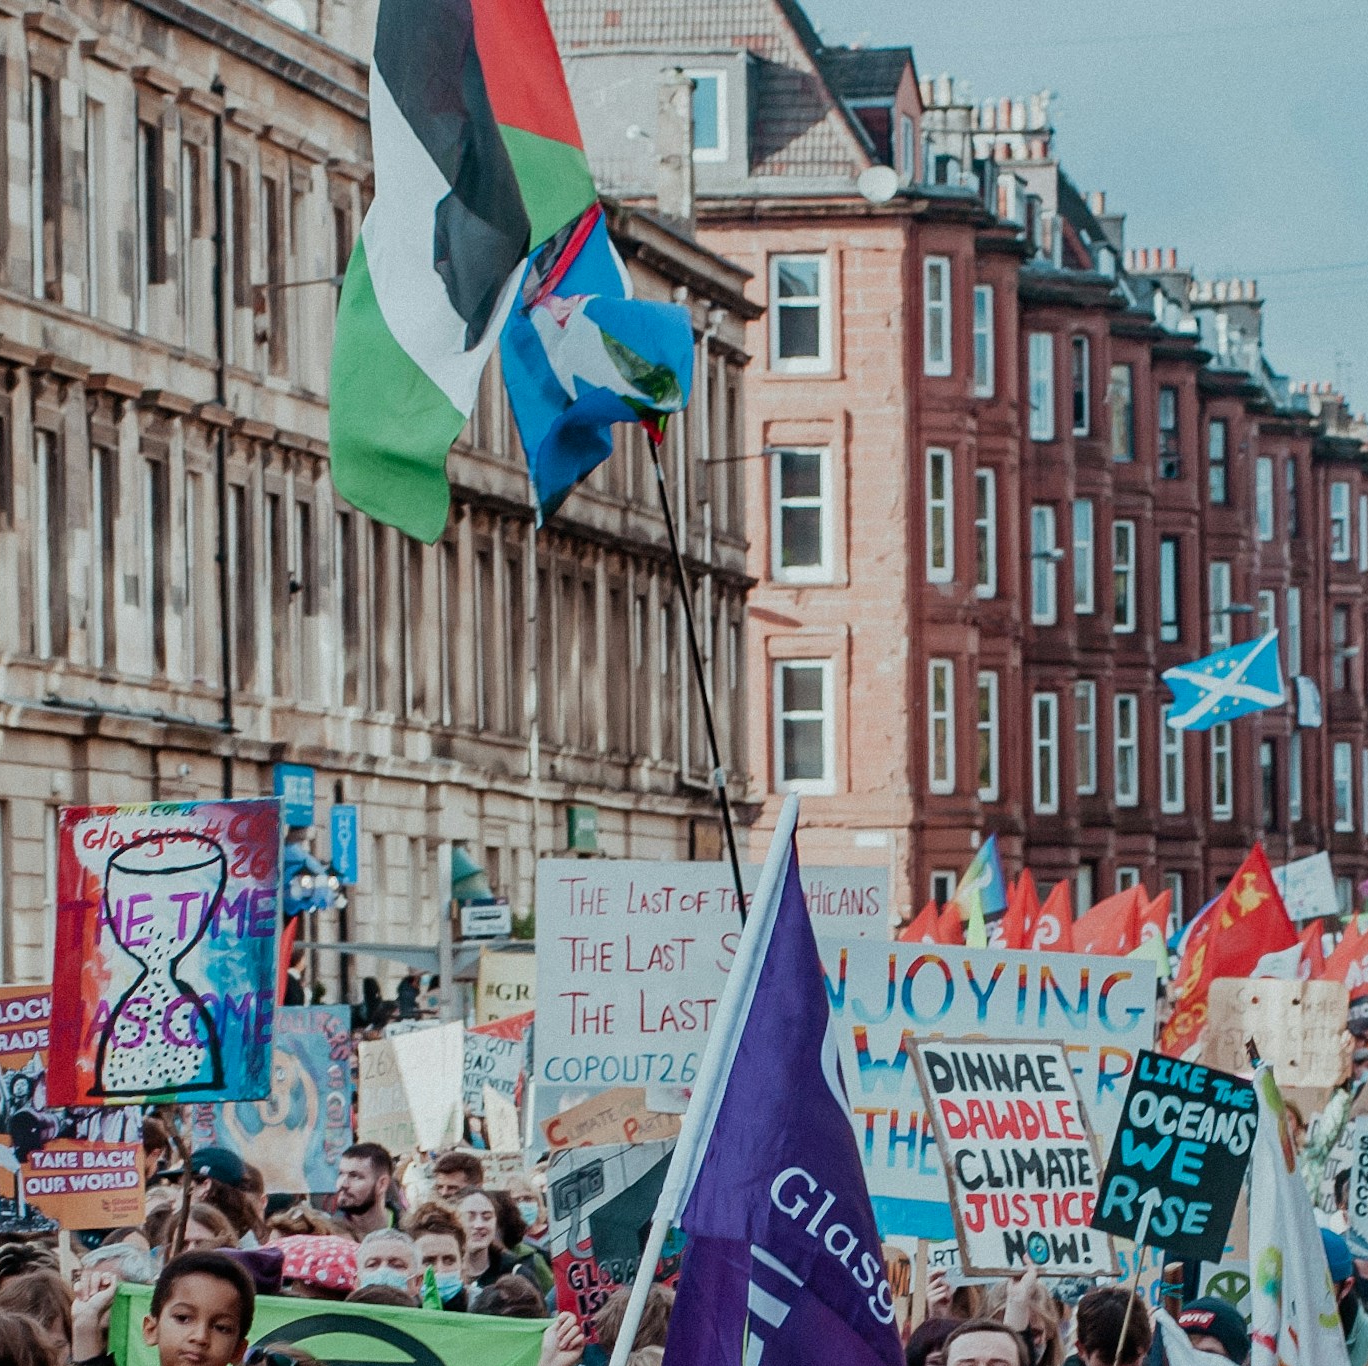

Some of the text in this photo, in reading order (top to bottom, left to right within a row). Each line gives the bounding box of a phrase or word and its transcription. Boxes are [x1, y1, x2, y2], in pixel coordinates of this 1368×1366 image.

[557, 878, 608, 916] THE
[626, 881, 677, 914] LAST
[679, 889, 711, 914] OF
[557, 936, 613, 972] THE
[626, 935, 696, 973] LAST
[557, 989, 718, 1035] THE LAST
[544, 1052, 698, 1083] COPOUT26
[924, 1050, 1065, 1093] DINNAE
[1138, 1055, 1207, 1095] LIKE
[939, 1098, 1086, 1141] DAWDLE
[1128, 1090, 1257, 1156] OCEANS
[32, 1151, 136, 1169] TAKE BACK
[953, 1147, 1095, 1190] CLIMATE
[1120, 1128, 1207, 1187] WE
[26, 1170, 140, 1195] OUR WORLD
[964, 1190, 1096, 1234] JUSTICE
[1002, 1230, 1093, 1266] NOW!
